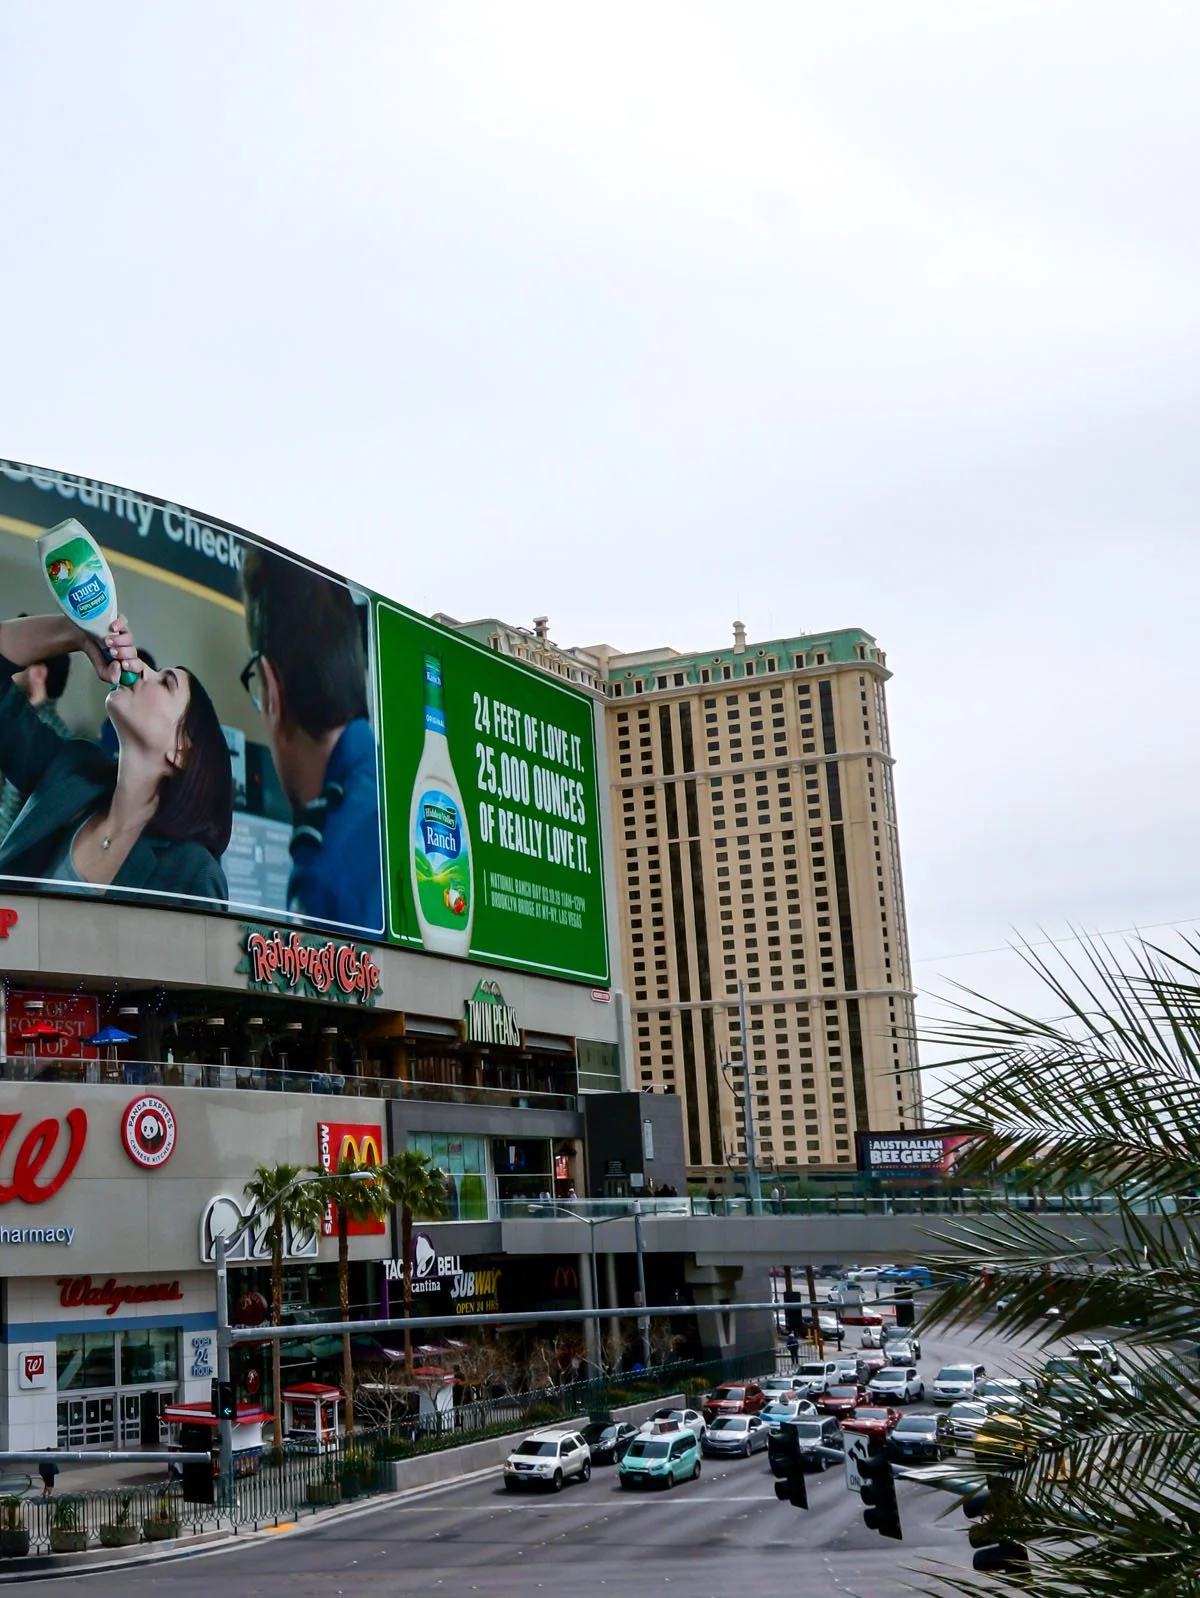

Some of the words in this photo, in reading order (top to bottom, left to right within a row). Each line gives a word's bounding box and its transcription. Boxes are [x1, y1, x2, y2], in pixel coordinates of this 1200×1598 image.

[163, 502, 245, 570] Check
[71, 580, 100, 602] Ranch
[426, 671, 442, 686] Ranch
[473, 691, 491, 735] 24
[493, 700, 521, 747] FEET
[524, 713, 538, 754] OF
[540, 720, 570, 767] LOVE
[570, 733, 585, 773] IT.
[475, 742, 530, 806] 25,000
[533, 764, 586, 826] OUNCES
[426, 826, 457, 852] Ranch
[479, 801, 495, 844] OF
[498, 807, 543, 859] REALLY
[546, 823, 576, 870] LOVE
[576, 834, 592, 875] IT.
[247, 930, 336, 993] Rainforest
[467, 1000, 494, 1043] TWIN
[493, 1004, 521, 1047] PEAKS
[128, 1101, 147, 1127] PANDA
[148, 1099, 173, 1129] EXPRESS
[130, 1139, 150, 1162] CHINESE
[151, 1142, 172, 1162] KITCHEN
[873, 1140, 943, 1150] AUSTRALIAN
[437, 1255, 464, 1277] BELL
[57, 1276, 184, 1315] Walgreens
[411, 1279, 441, 1293] cantina
[450, 1269, 502, 1299] SUBWAY
[456, 1302, 475, 1314] OPEN
[476, 1301, 484, 1312] 24
[192, 1337, 212, 1349] open
[194, 1348, 209, 1367] 24
[191, 1366, 214, 1377] hours
